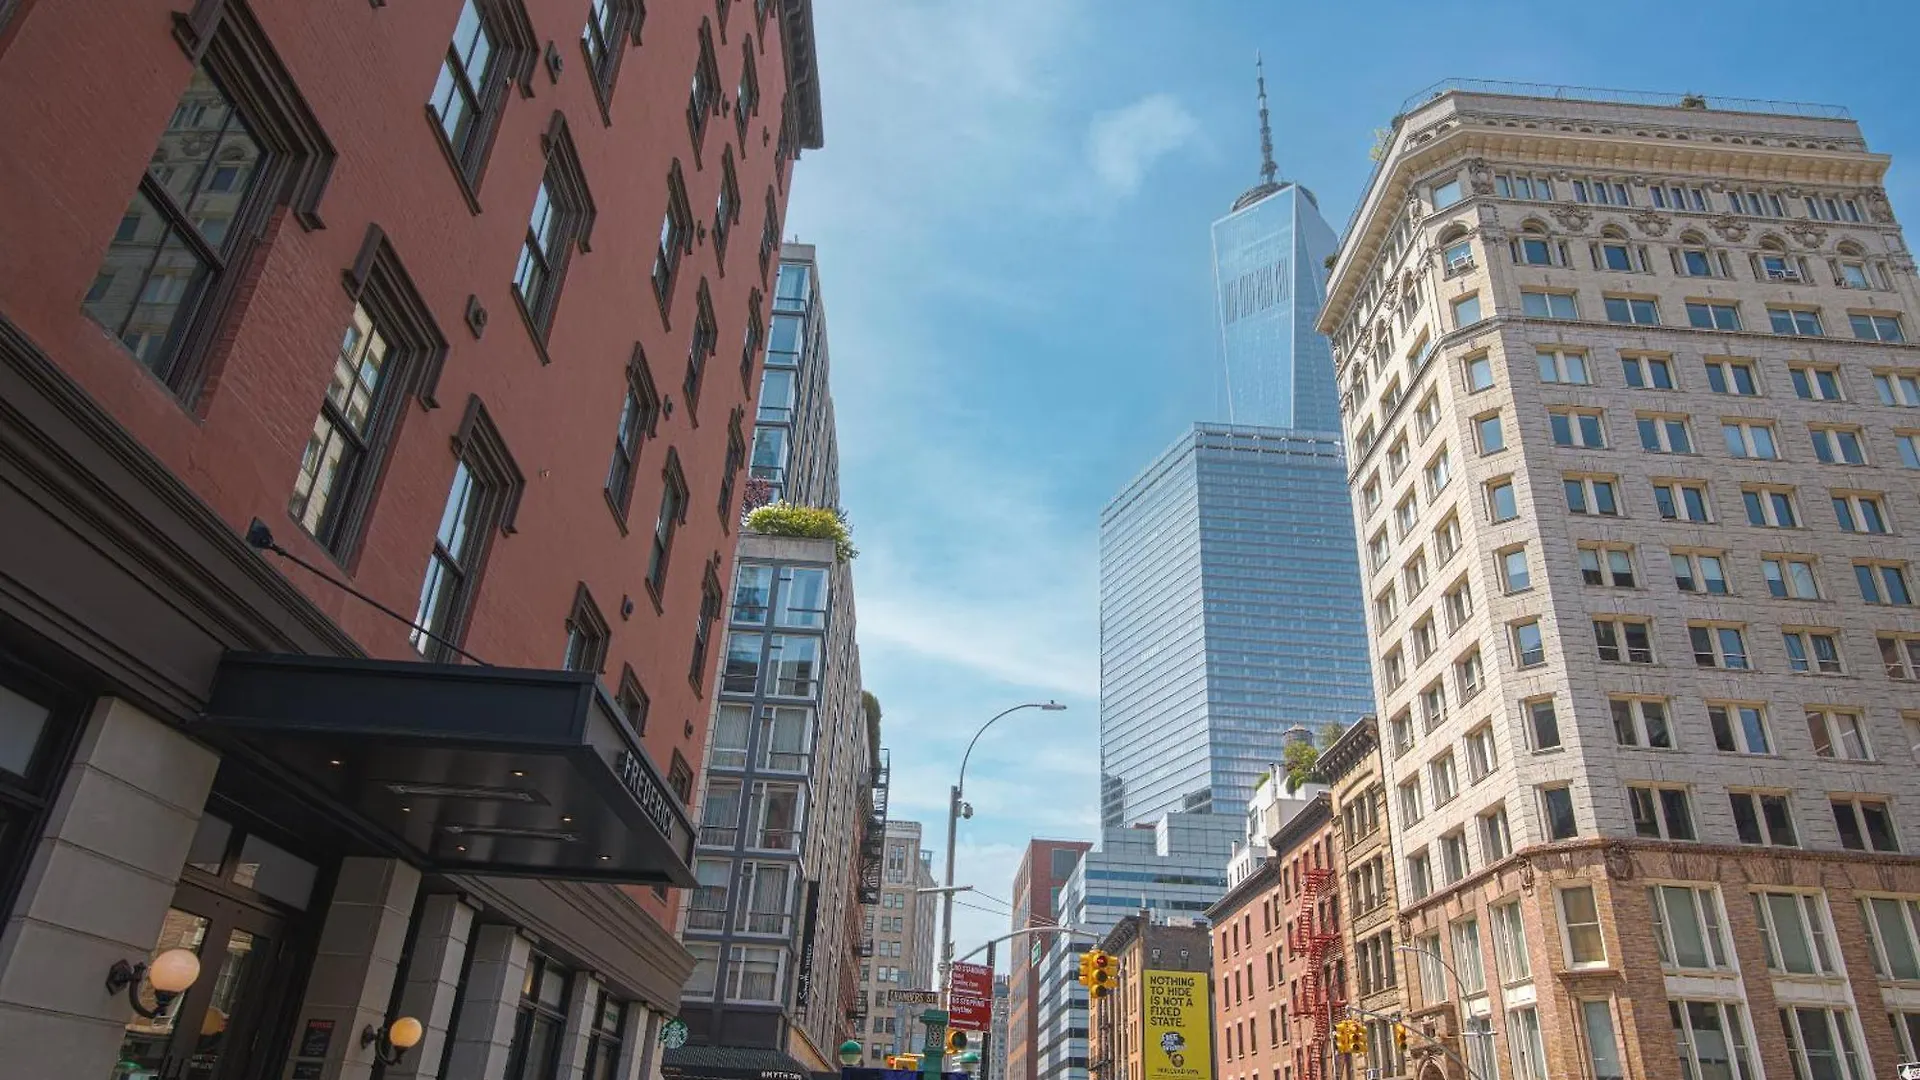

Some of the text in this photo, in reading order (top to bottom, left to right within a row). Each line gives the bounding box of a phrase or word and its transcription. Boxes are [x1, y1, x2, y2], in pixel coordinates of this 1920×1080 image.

[624, 750, 675, 840] FREDERICK
[1150, 976, 1195, 986] NOTHING
[1150, 986, 1192, 997] TO HIDE
[1150, 996, 1193, 1007] IS NOT A
[1150, 1006, 1181, 1016] FIXED
[1150, 1016, 1186, 1027] STATE.
[761, 1071, 788, 1079] SMYTH
